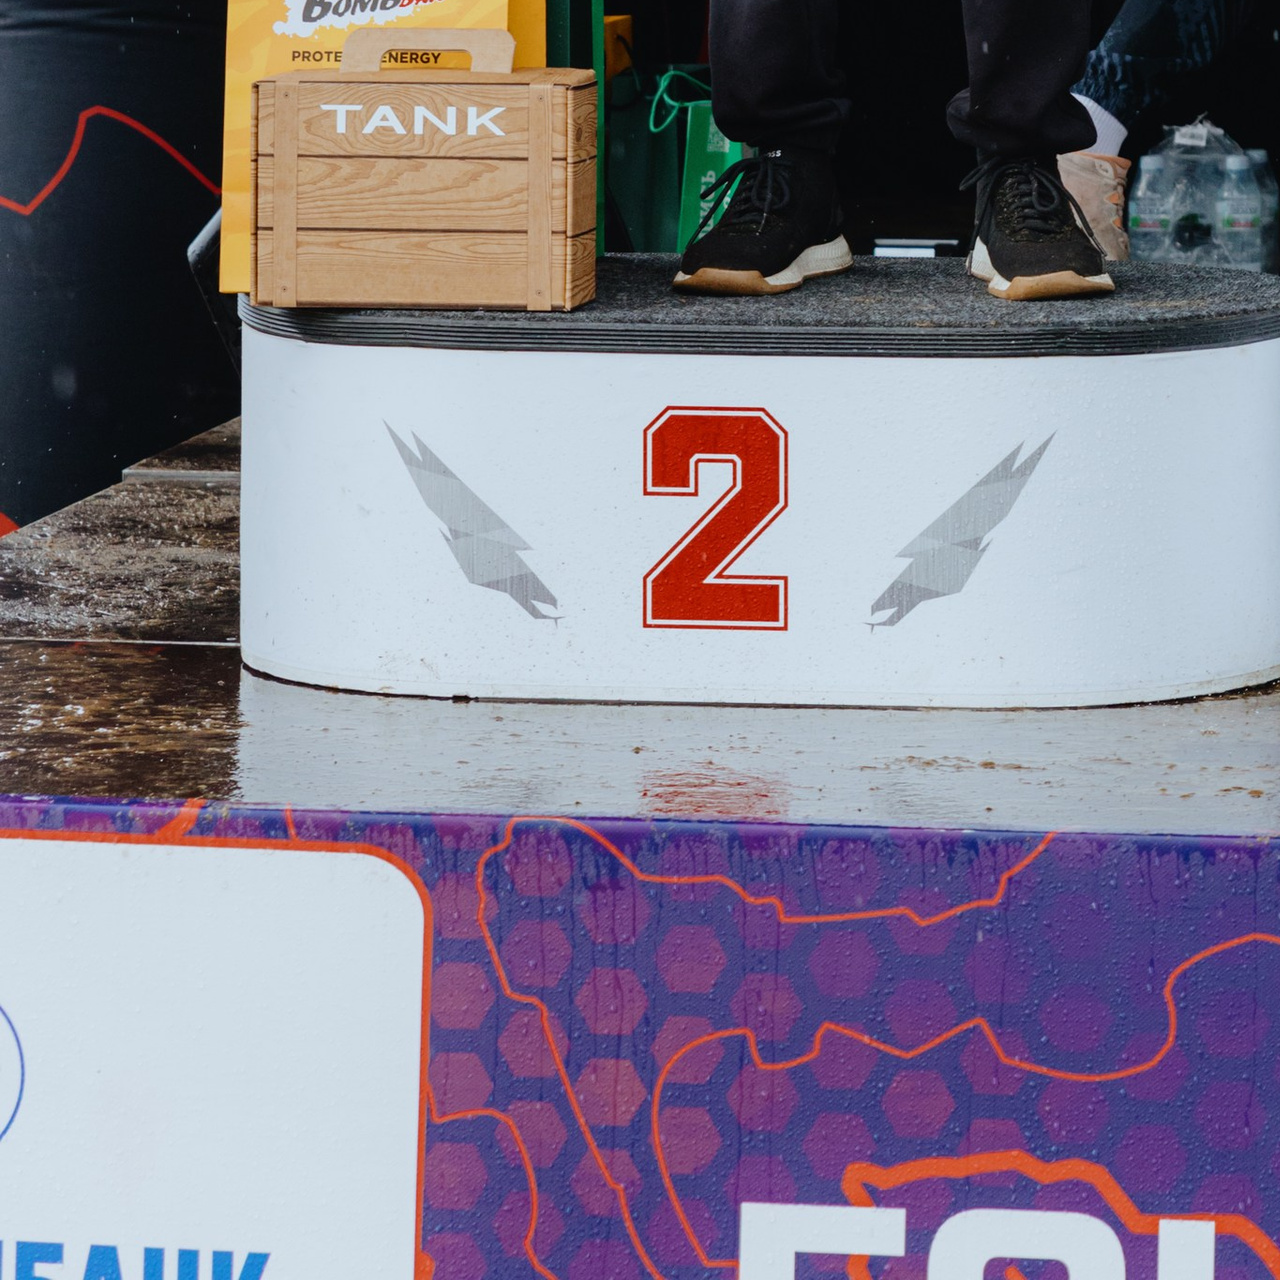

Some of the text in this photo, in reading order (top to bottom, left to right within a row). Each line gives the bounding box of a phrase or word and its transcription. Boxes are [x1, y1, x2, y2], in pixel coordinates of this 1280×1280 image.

[292, 50, 342, 63] PROTE
[320, 104, 508, 136] TANK
[643, 405, 788, 631] 2
